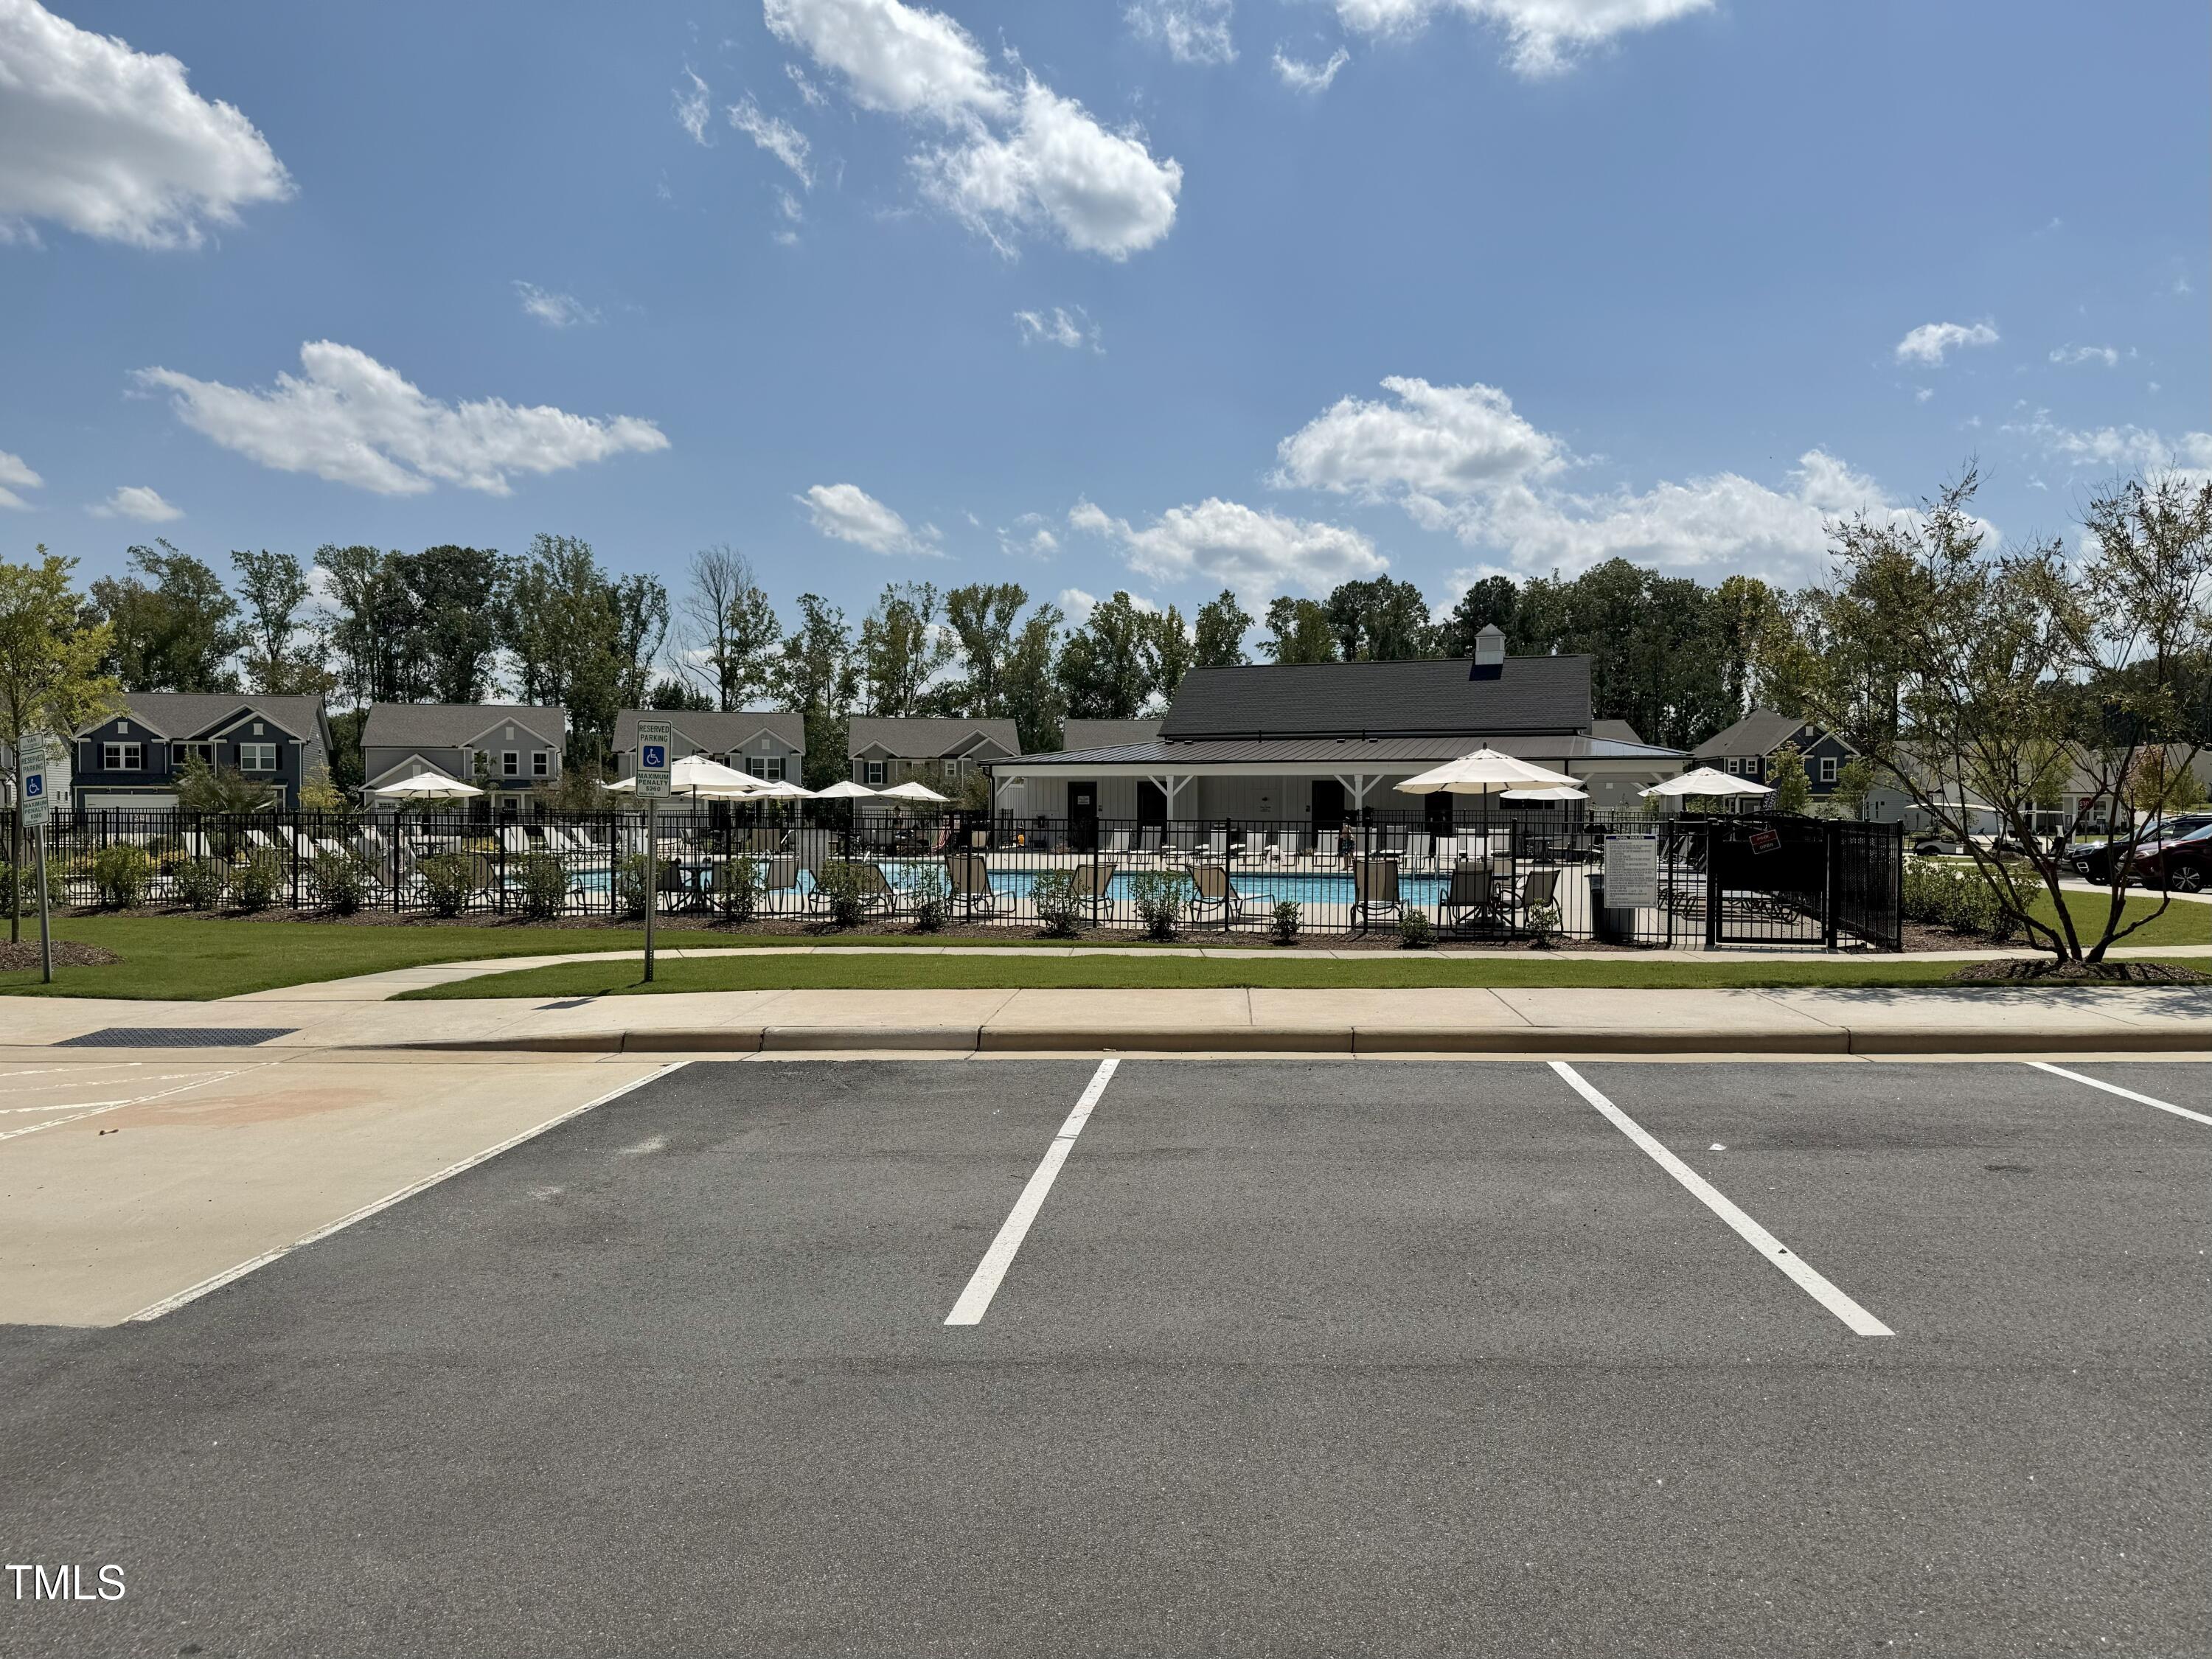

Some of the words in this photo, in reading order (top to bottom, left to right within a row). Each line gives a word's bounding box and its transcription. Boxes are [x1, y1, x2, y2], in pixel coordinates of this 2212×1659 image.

[21, 754, 44, 765] RESERVED
[23, 763, 44, 773] PARKING
[24, 800, 47, 809] MAXIMUM
[24, 805, 47, 814] PENALTY
